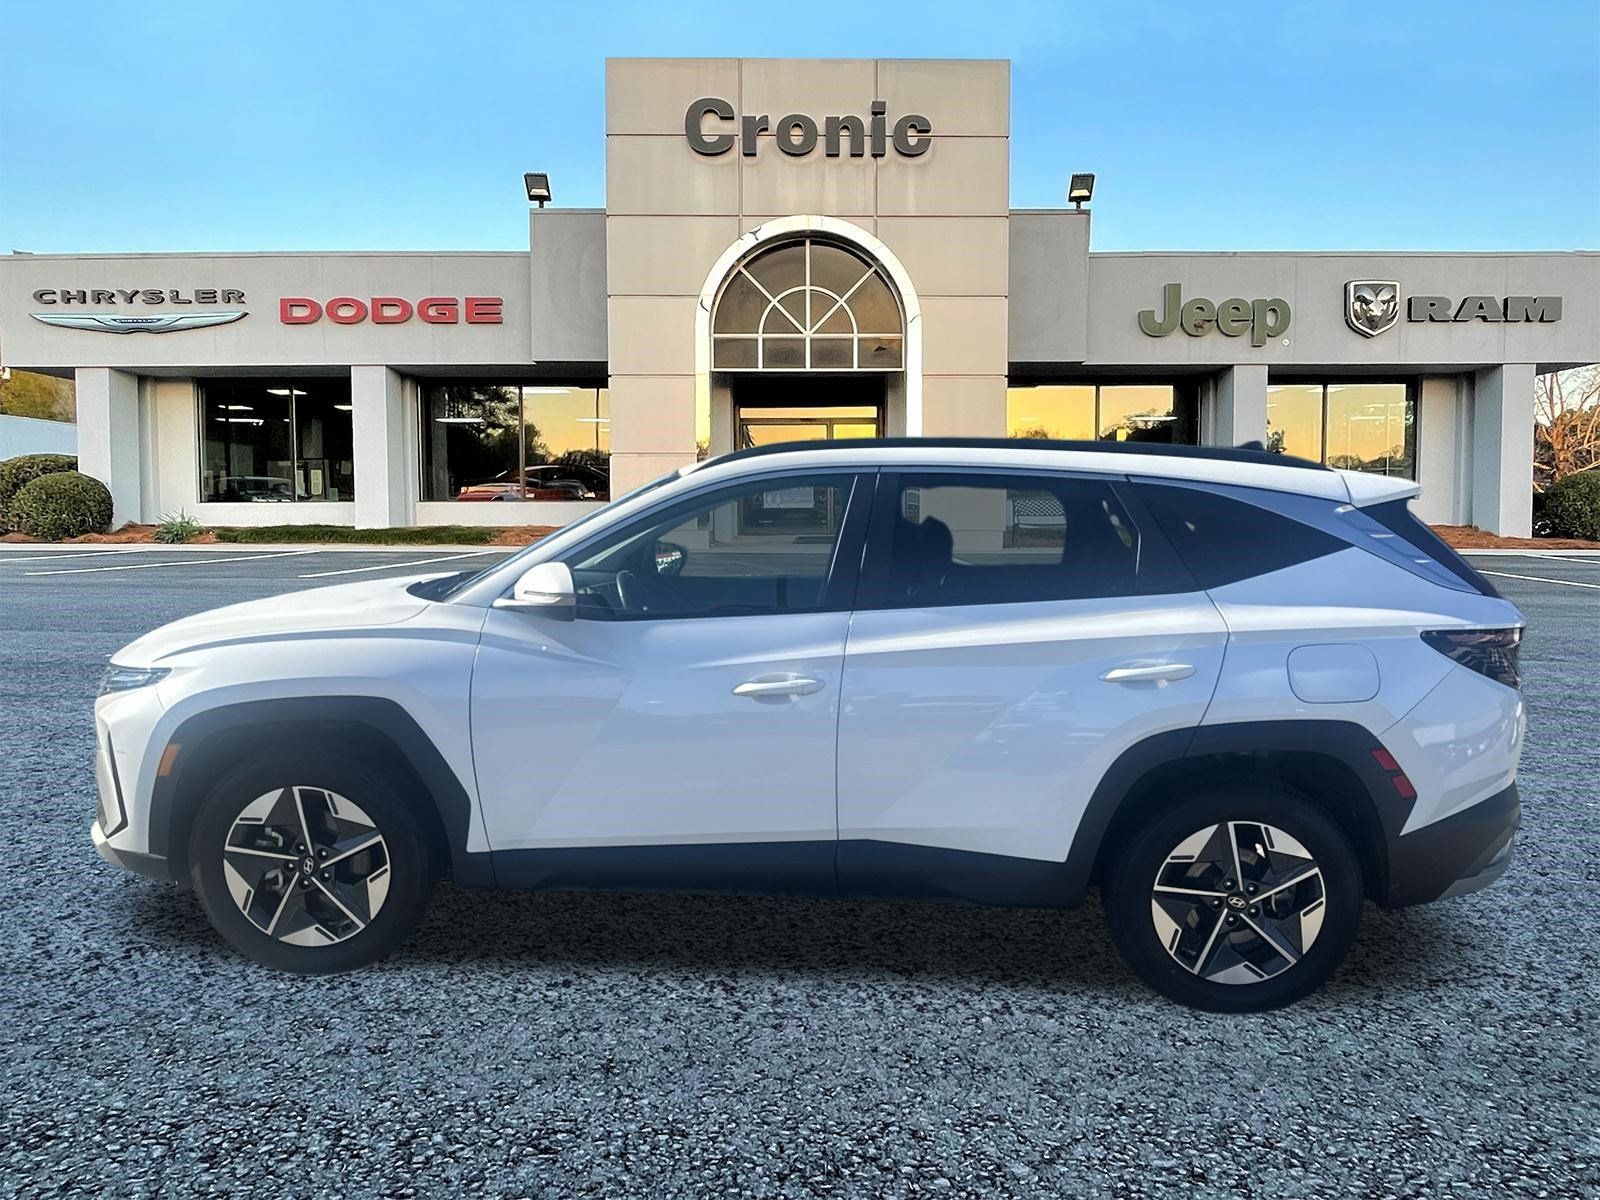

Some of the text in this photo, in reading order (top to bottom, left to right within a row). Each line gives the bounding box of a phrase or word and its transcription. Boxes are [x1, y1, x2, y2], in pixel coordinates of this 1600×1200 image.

[685, 97, 932, 157] Cronic
[32, 288, 247, 305] CHRYSLER
[1407, 296, 1562, 323] RAM
[280, 297, 503, 324] DODGE
[1138, 283, 1291, 347] Jeep
